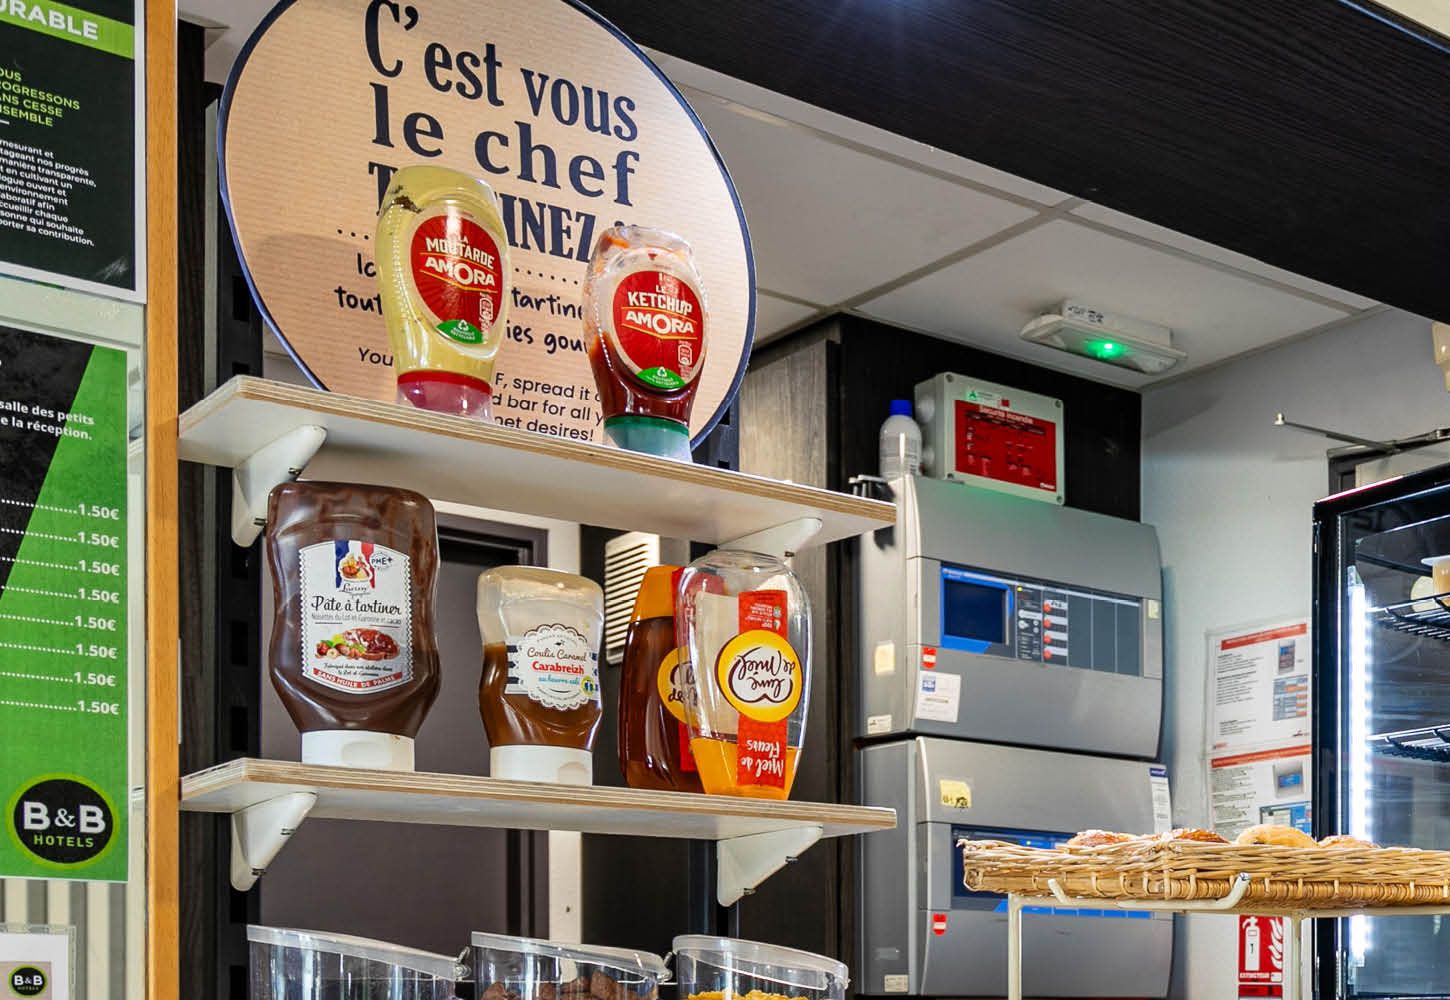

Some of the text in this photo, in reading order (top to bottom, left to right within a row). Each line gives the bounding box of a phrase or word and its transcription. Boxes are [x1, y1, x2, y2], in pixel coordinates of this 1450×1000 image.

[0, 81, 80, 110] OGRESSONS
[520, 68, 638, 141] vous
[0, 105, 53, 127] SEMBLE
[23, 99, 63, 118] CESSE
[369, 83, 640, 206] le chef
[44, 151, 54, 159] et
[37, 157, 53, 167] nos
[55, 162, 89, 176] progrès
[20, 171, 59, 186] cultivant
[60, 181, 72, 189] un
[38, 165, 96, 188] transparente,
[26, 181, 55, 194] ouvert
[37, 200, 55, 211] afin
[368, 161, 597, 263] TINEZ
[34, 209, 68, 223] chaque
[26, 224, 36, 232] sa
[38, 227, 94, 247] contribution.
[46, 219, 84, 235] souhaite
[425, 237, 495, 269] MOUTARDE
[425, 256, 495, 287] AMORA
[627, 291, 692, 316] KETCHUP
[625, 310, 694, 335] AMORA
[544, 333, 588, 354] gou
[513, 376, 576, 400] spread
[579, 385, 592, 401] it
[32, 404, 55, 418] des
[57, 410, 95, 426] petits
[507, 394, 591, 421] bar for all
[12, 416, 24, 429] la
[27, 419, 93, 441] réception.
[526, 421, 594, 442] desires!
[78, 503, 120, 520] 1.50€
[77, 531, 120, 548] 1.50€
[78, 559, 120, 577] 1.50€
[78, 588, 120, 604] 1.50€
[311, 595, 402, 615] Pâte à tartiner
[74, 615, 116, 631] 1.50€
[75, 643, 118, 660] 1.50€
[527, 647, 588, 662] Coulis Caramel
[532, 661, 585, 675] Carabreizh
[74, 671, 116, 687] 1.50€
[77, 700, 120, 715] 1.50€
[23, 801, 106, 834] B&B
[33, 835, 94, 848] HOTELS
[14, 975, 43, 986] B&B
